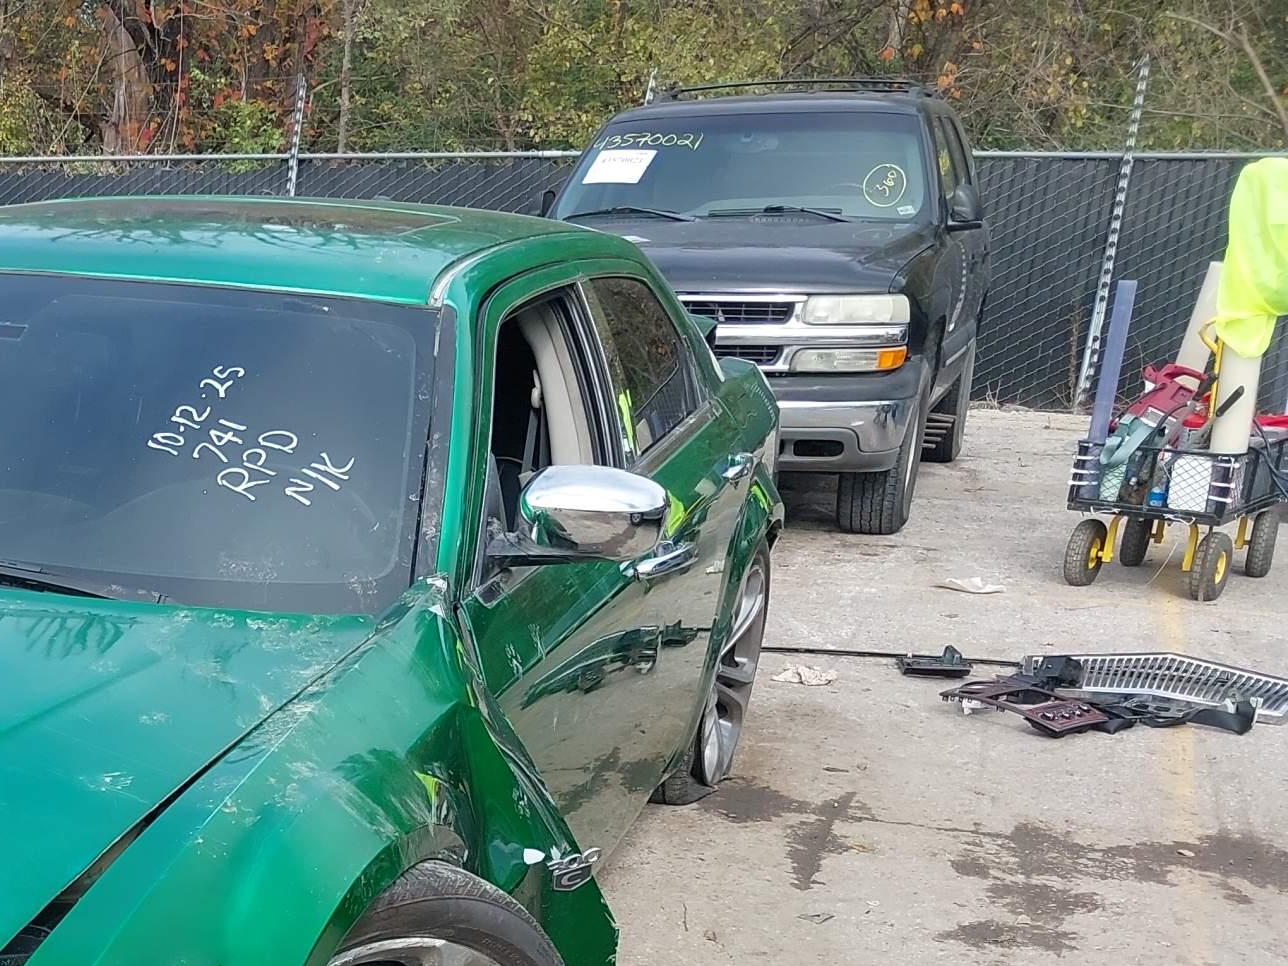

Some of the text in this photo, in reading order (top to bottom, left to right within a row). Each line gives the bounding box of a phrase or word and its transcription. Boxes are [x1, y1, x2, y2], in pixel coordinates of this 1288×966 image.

[593, 132, 704, 151] 43570021
[876, 170, 897, 197] 360
[192, 418, 247, 463] 741
[216, 430, 299, 501] RPD
[561, 870, 583, 886] C
